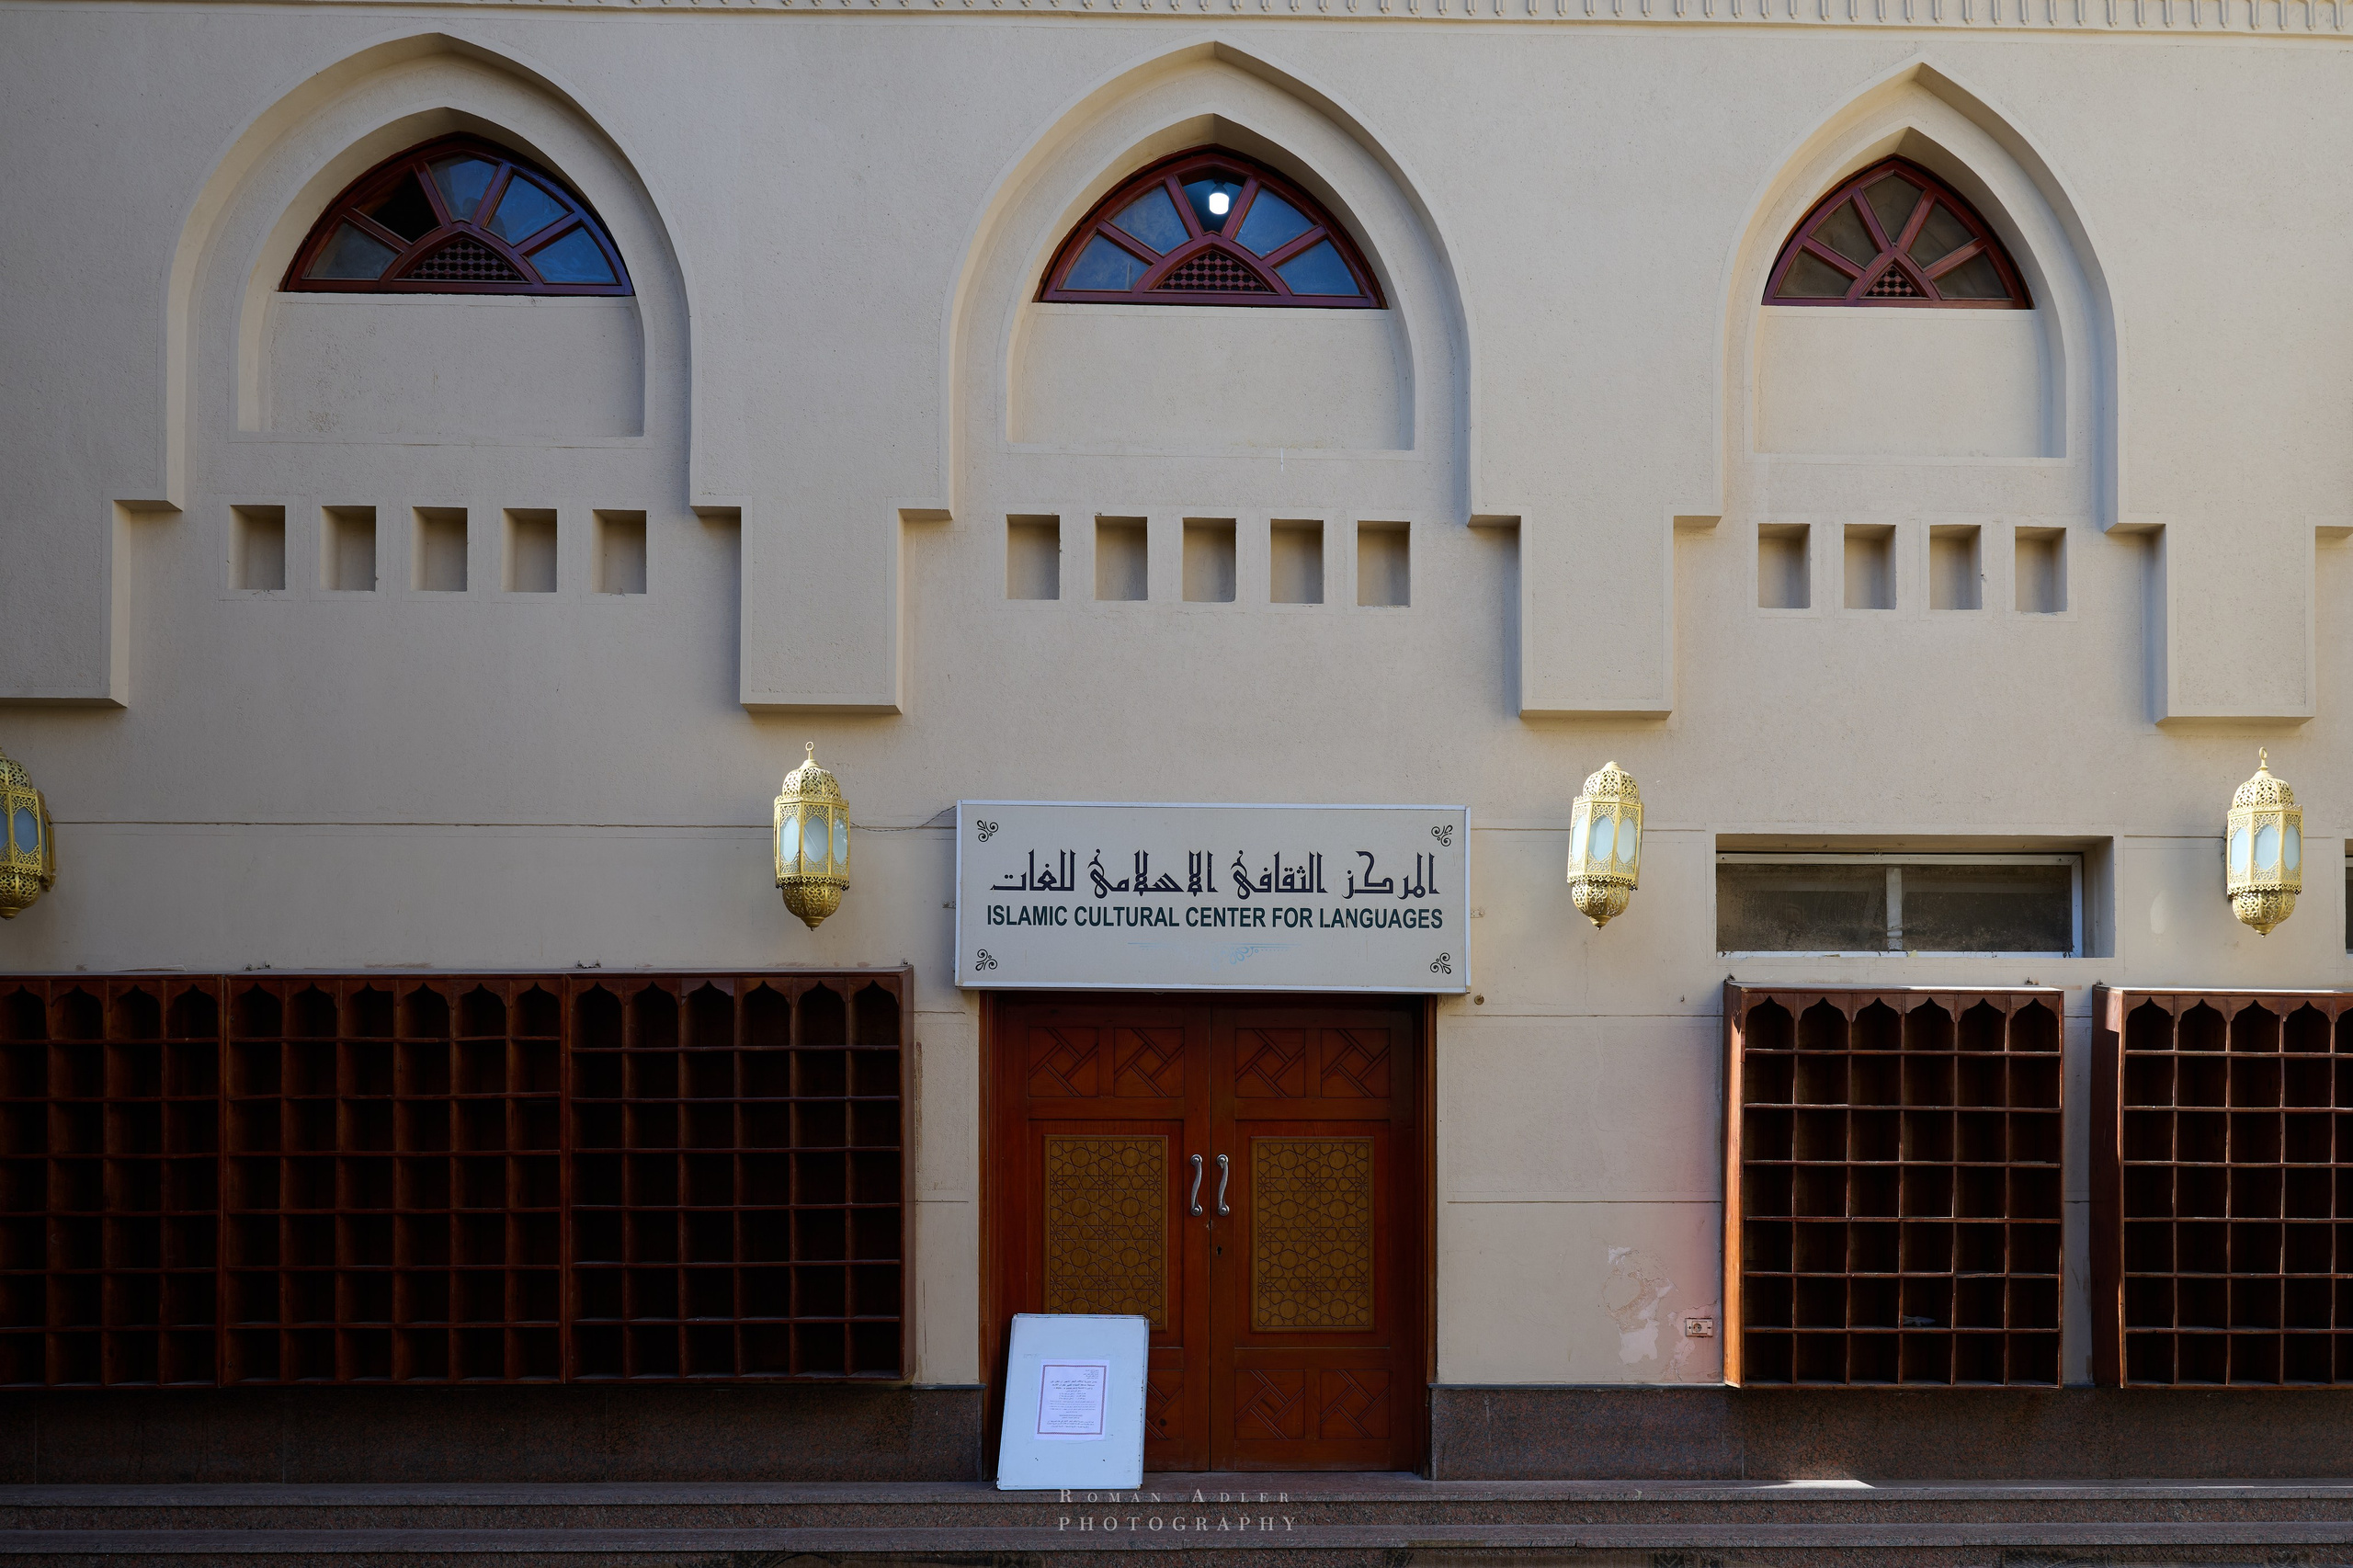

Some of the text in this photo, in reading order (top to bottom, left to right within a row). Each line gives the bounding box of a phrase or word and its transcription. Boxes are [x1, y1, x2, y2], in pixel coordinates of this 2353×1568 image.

[989, 848, 1076, 892] للغات
[1341, 850, 1440, 901] المركز
[987, 904, 1443, 929] ISLAMIC CULTURAL CENTER FOR LANGUAGES
